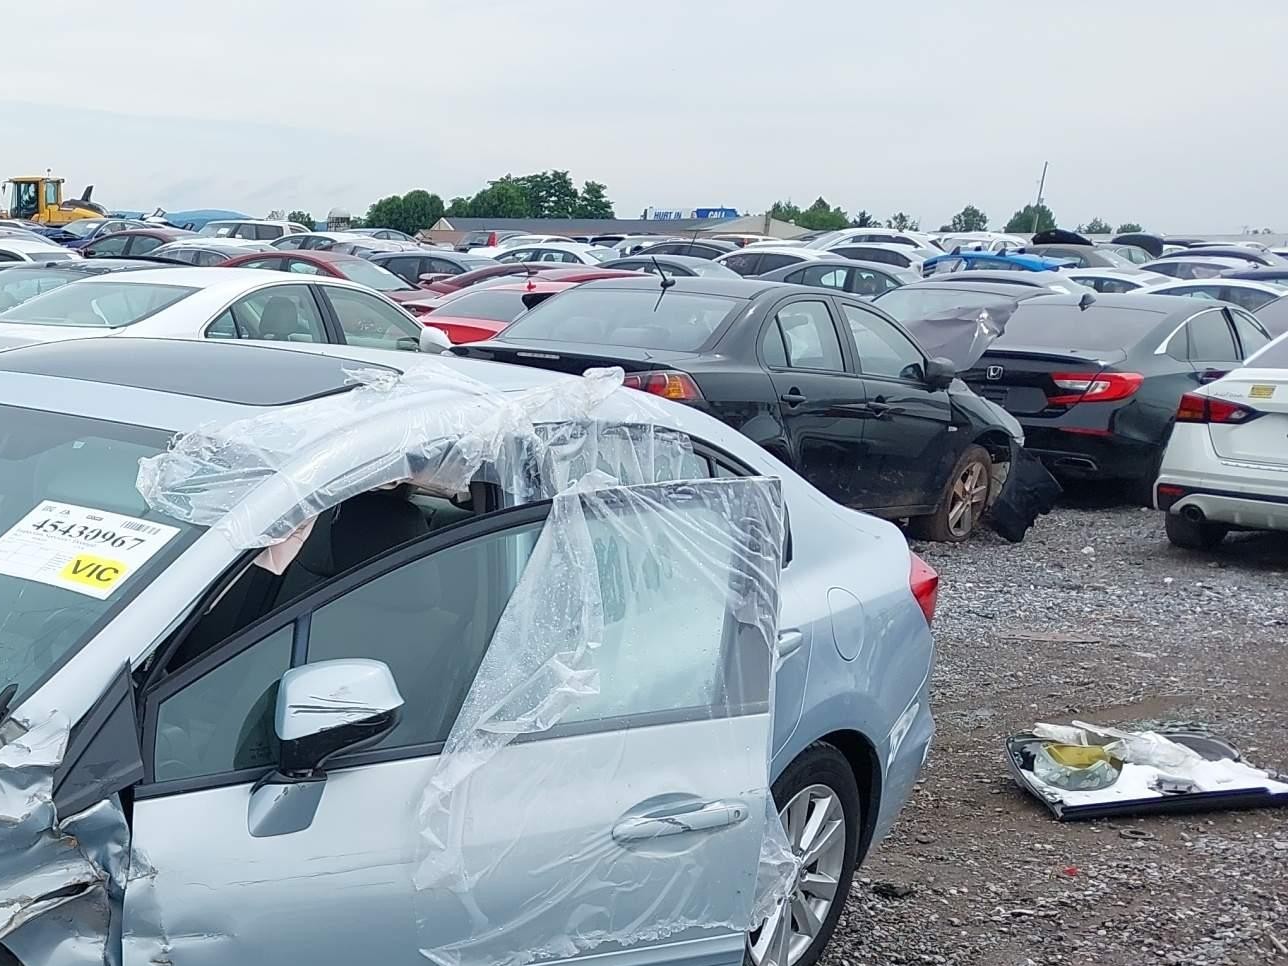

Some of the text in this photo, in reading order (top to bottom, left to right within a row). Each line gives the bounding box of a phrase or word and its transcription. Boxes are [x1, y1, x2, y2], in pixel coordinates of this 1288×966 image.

[654, 211, 672, 220] HURT
[674, 211, 682, 219] IN
[32, 518, 146, 550] 45430967
[72, 560, 119, 582] VIC
